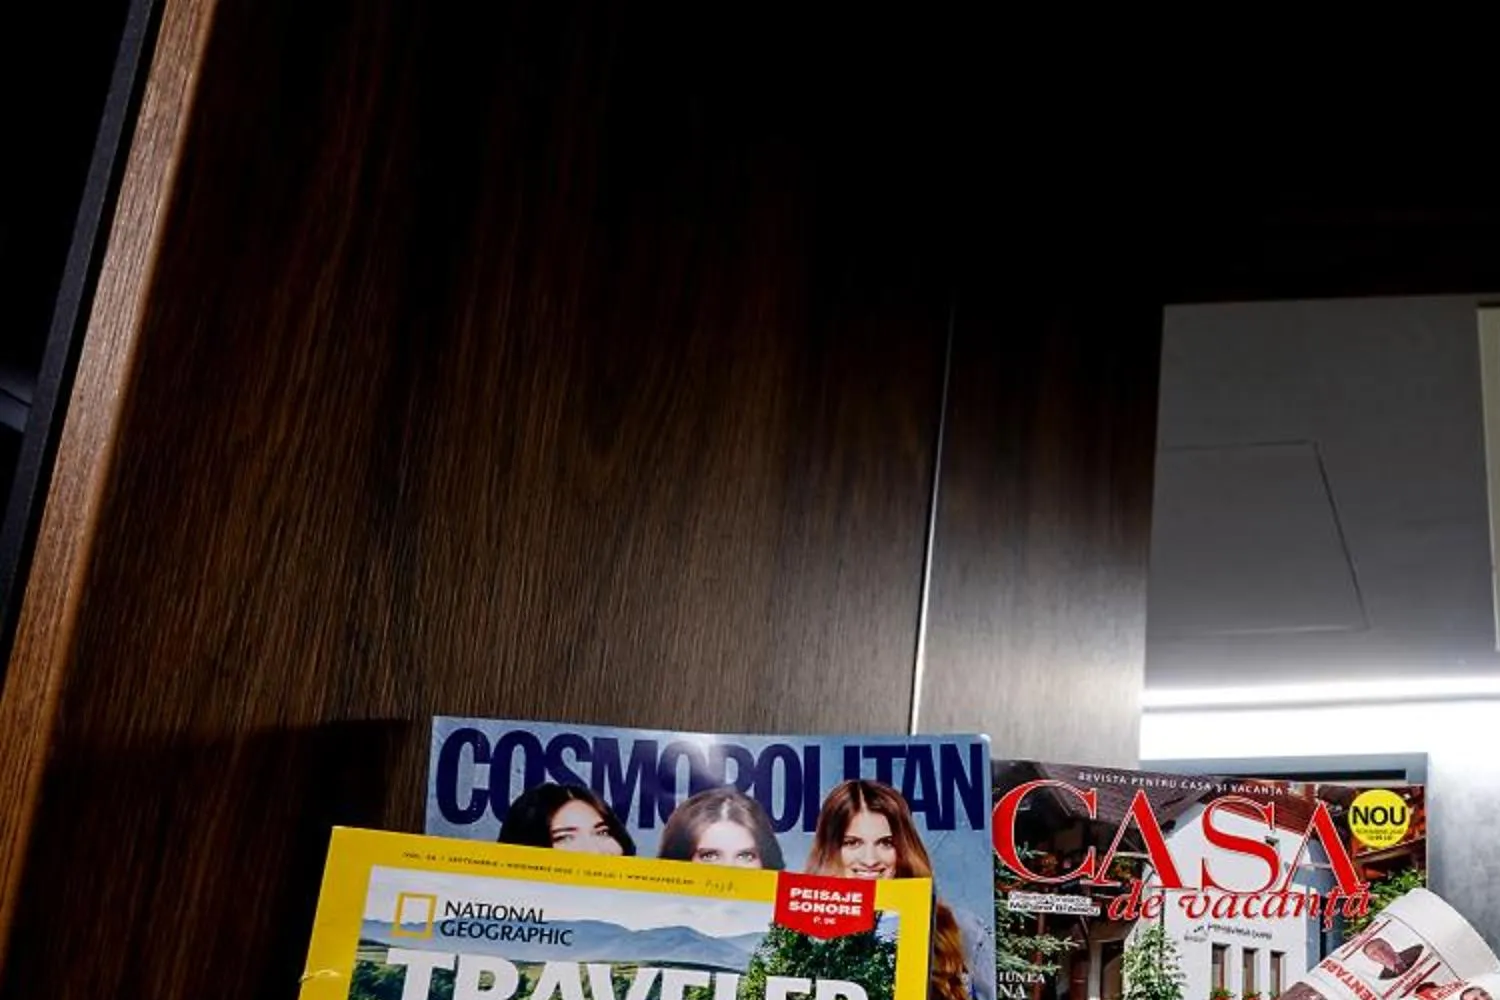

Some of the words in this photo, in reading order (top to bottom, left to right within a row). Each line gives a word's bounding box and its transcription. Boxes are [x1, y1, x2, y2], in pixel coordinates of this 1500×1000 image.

[1352, 806, 1406, 826] NOU
[991, 779, 1376, 896] CASA
[790, 887, 863, 903] PEISAJE
[1108, 879, 1162, 922] de
[445, 901, 549, 925] NATIONAL
[788, 901, 862, 916] SONORE
[440, 919, 574, 947] GEOGRAPHIC
